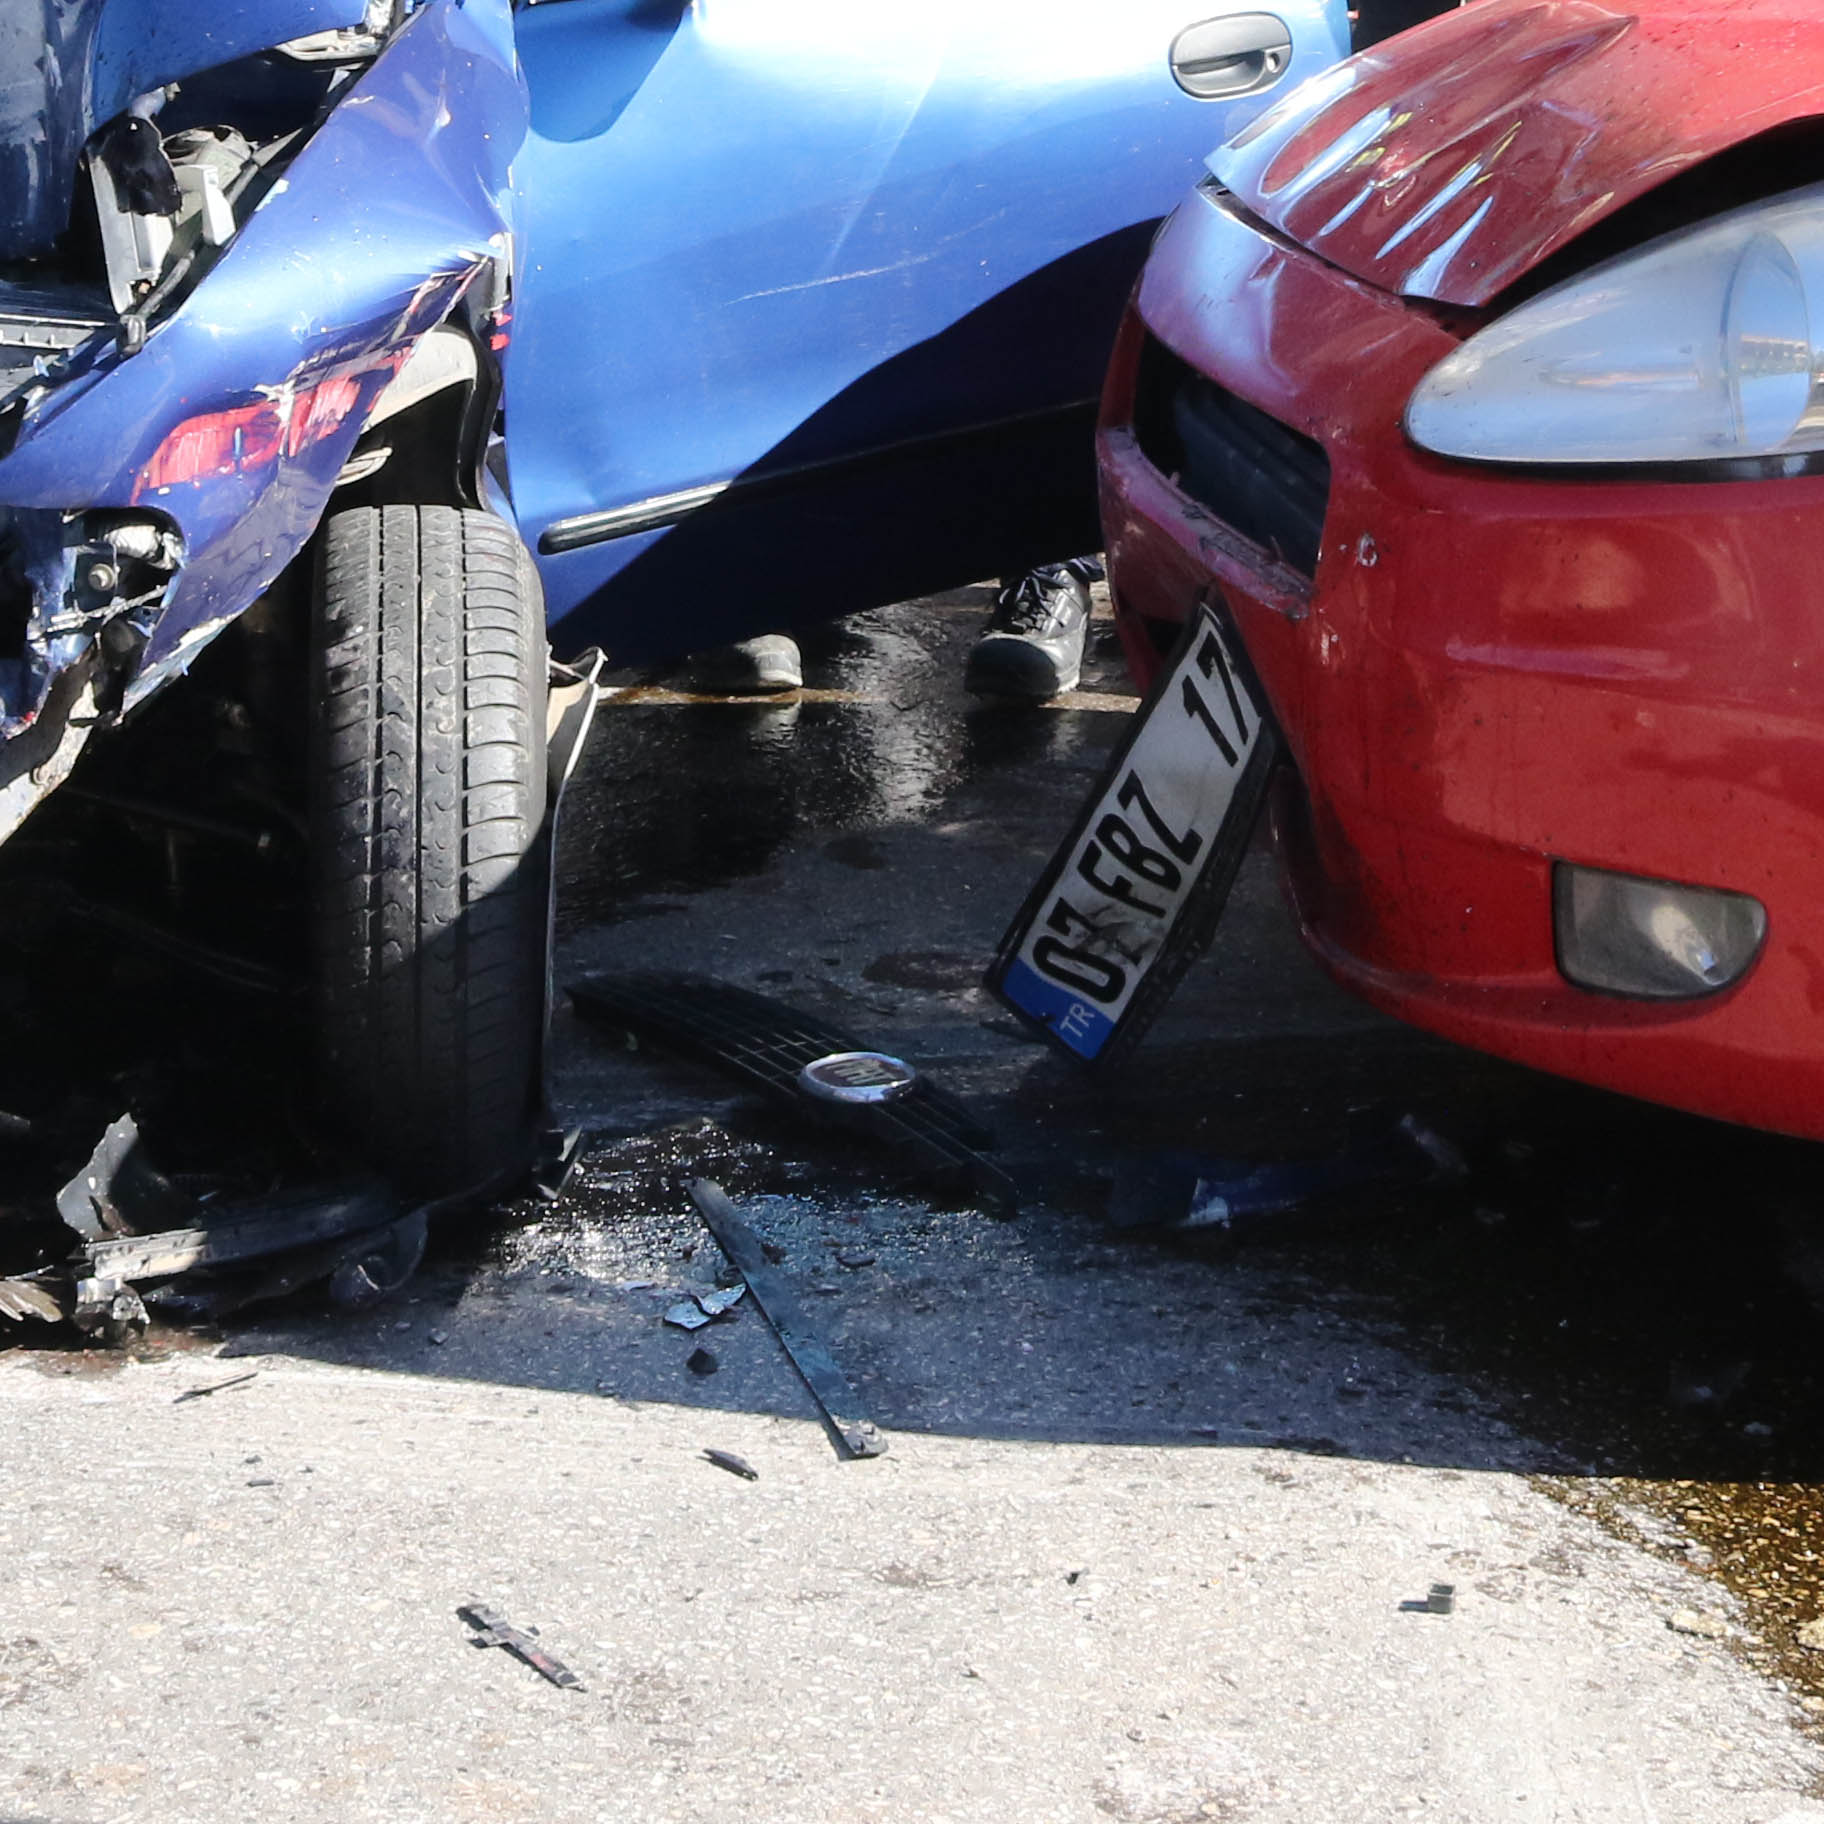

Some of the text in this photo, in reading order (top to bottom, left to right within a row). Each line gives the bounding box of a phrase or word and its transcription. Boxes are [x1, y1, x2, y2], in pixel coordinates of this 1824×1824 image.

[1181, 630, 1249, 768] 17
[1077, 769, 1204, 919] FBZ
[1060, 1002, 1096, 1040] TR
